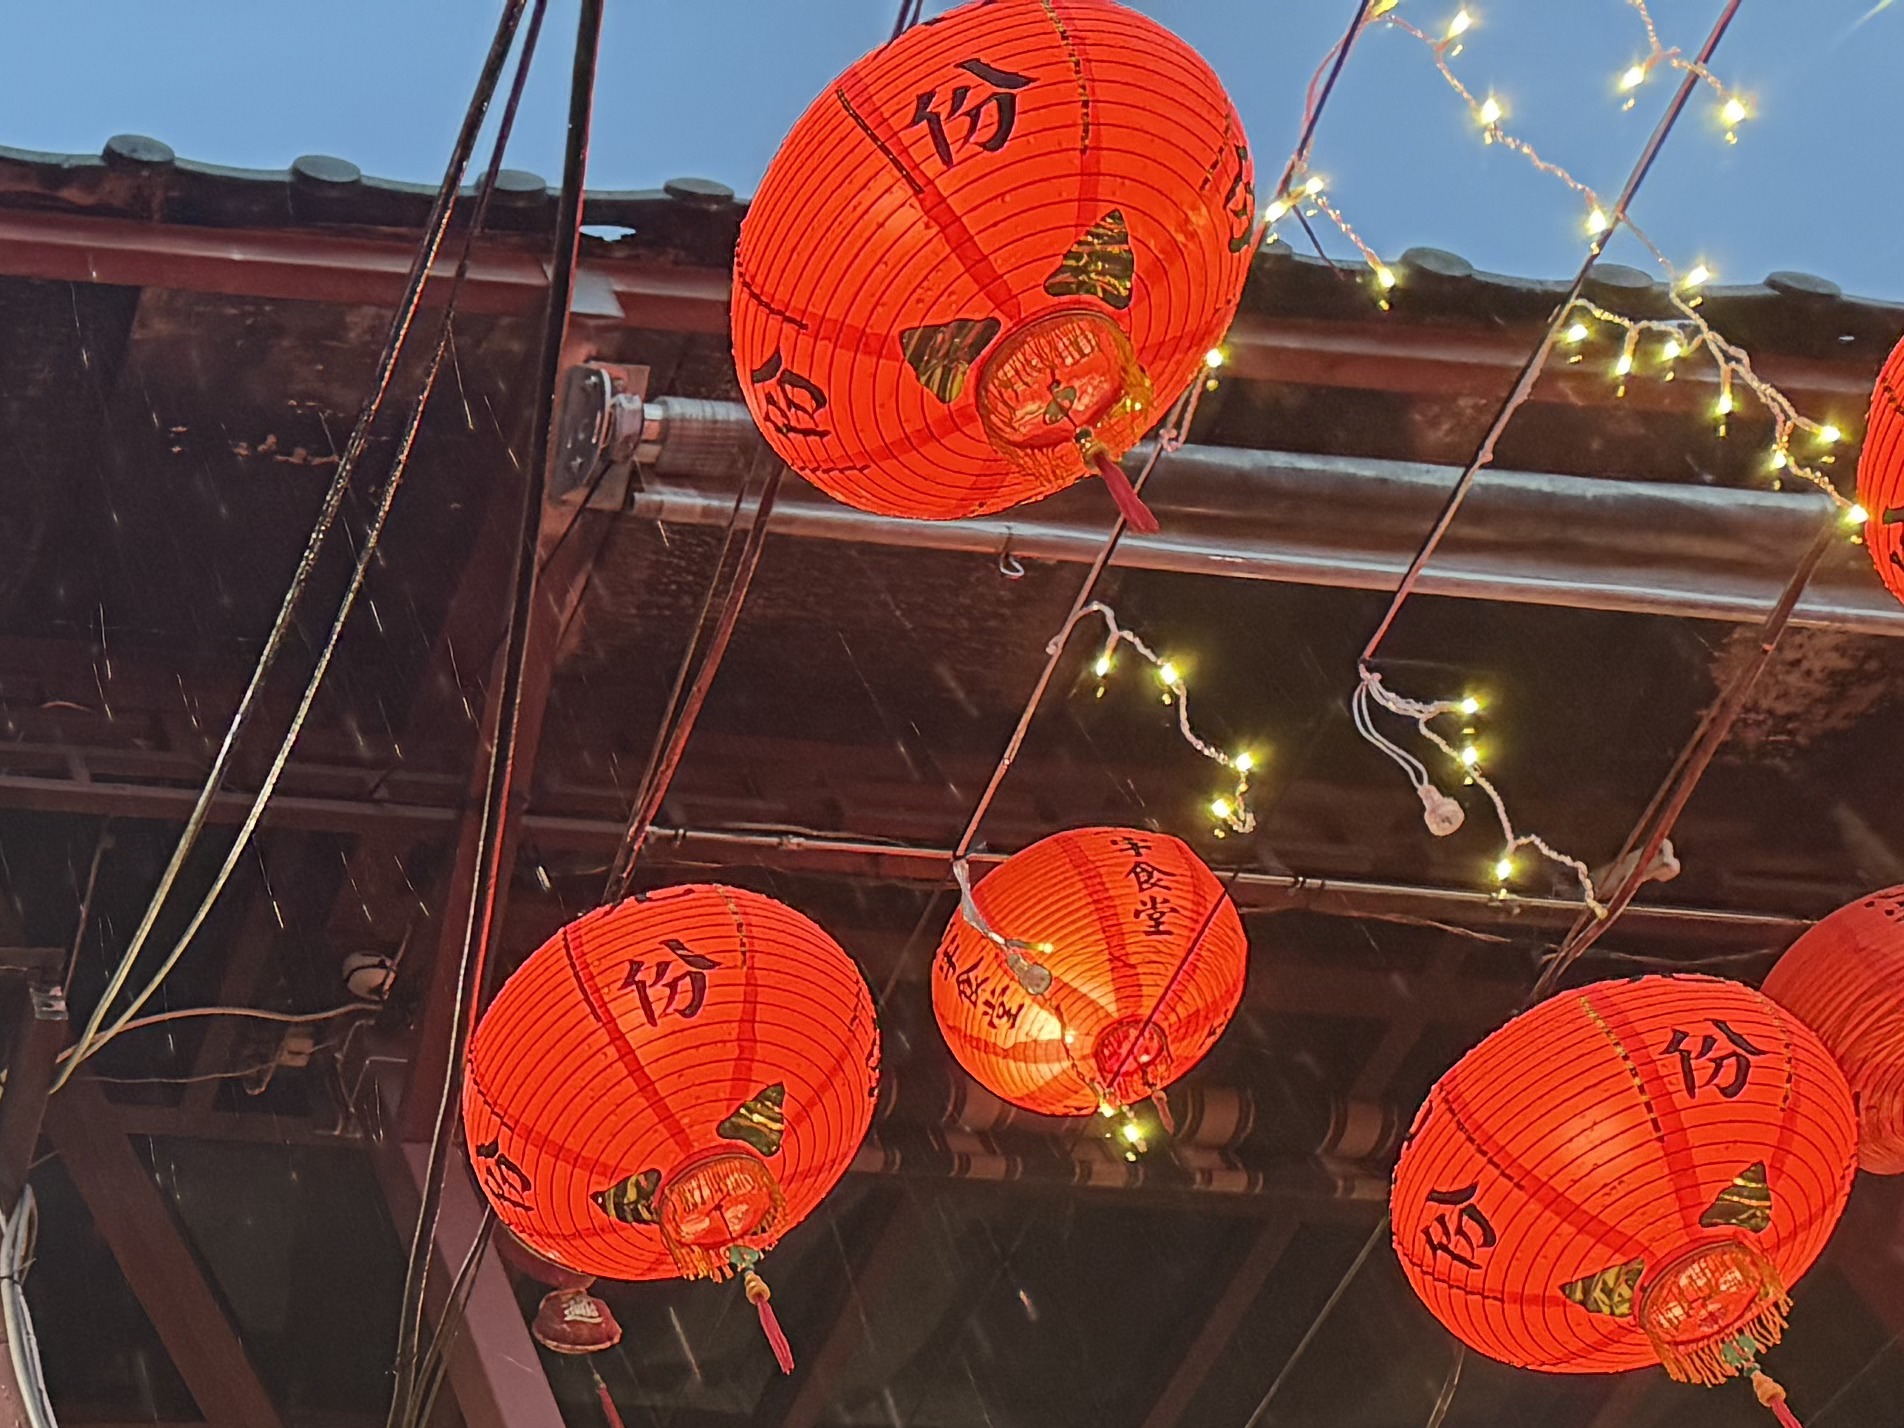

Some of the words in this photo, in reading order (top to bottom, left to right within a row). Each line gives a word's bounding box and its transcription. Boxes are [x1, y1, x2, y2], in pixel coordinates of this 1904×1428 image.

[907, 57, 1040, 168] 份
[619, 939, 720, 1028] 份
[1659, 1018, 1768, 1099] 份
